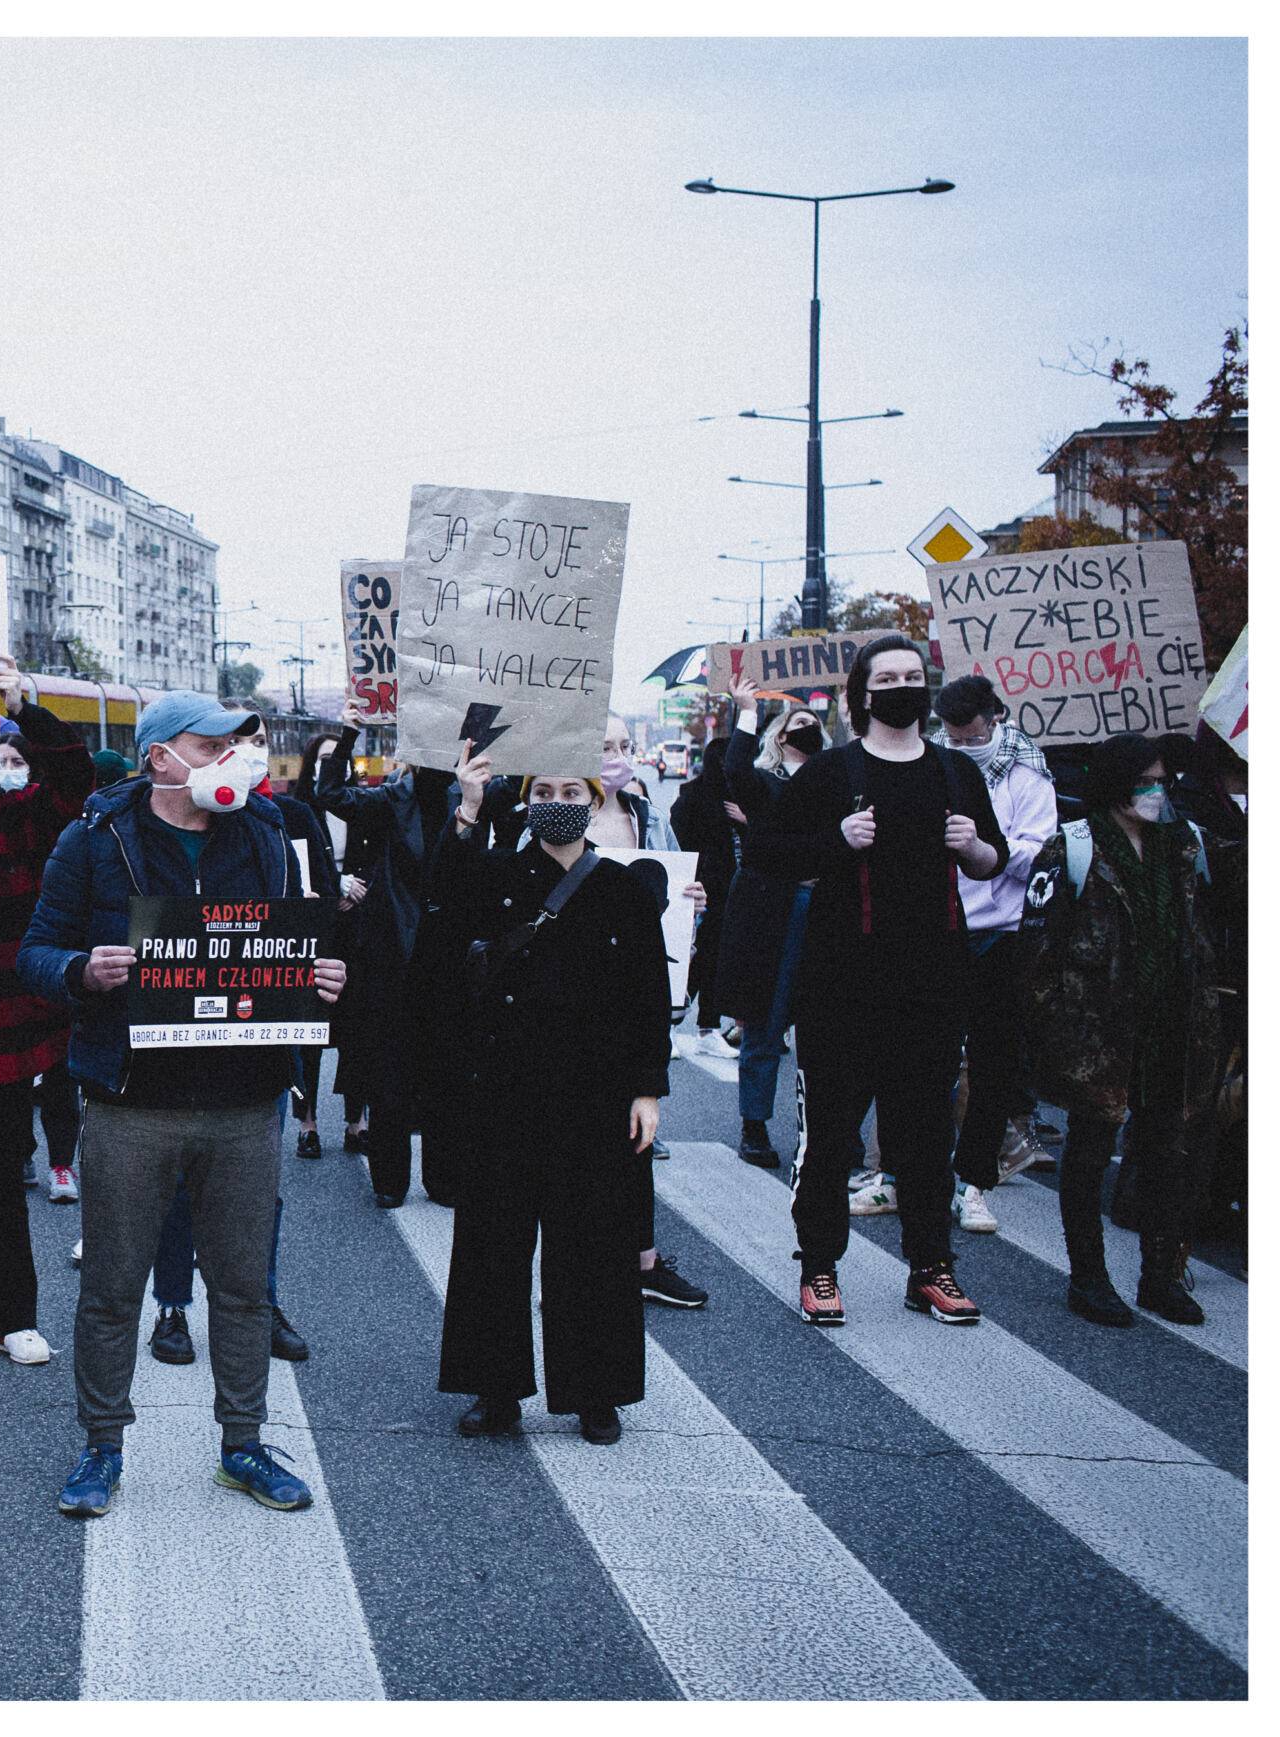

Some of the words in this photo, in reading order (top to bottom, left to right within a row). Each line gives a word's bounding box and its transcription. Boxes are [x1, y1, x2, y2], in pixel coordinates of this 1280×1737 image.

[429, 514, 468, 562] JA
[493, 518, 588, 578] STOJĘ
[348, 574, 391, 609] CO
[939, 545, 1147, 608] KACZYŃSKI
[422, 577, 459, 626] JA
[482, 584, 591, 632] TAŃCZĘ
[347, 612, 384, 640] ZA
[948, 613, 997, 654] TY
[419, 641, 455, 685] JA
[479, 648, 599, 695] WALCZĘ
[1157, 636, 1204, 681] CIĘ
[1001, 677, 1189, 738] OZJEBIE
[202, 900, 270, 922] SADYŚCI
[142, 939, 197, 959] PRAWO
[209, 939, 230, 959] DO
[242, 938, 317, 959] ABORCJI
[141, 968, 206, 988] PRAWEM
[217, 967, 315, 988] CZŁOWIEKA
[132, 1030, 167, 1042] ABORCJA
[173, 1030, 189, 1041] BEZ
[238, 1028, 254, 1040] +48
[261, 1028, 271, 1039] 22
[294, 1028, 305, 1039] 22
